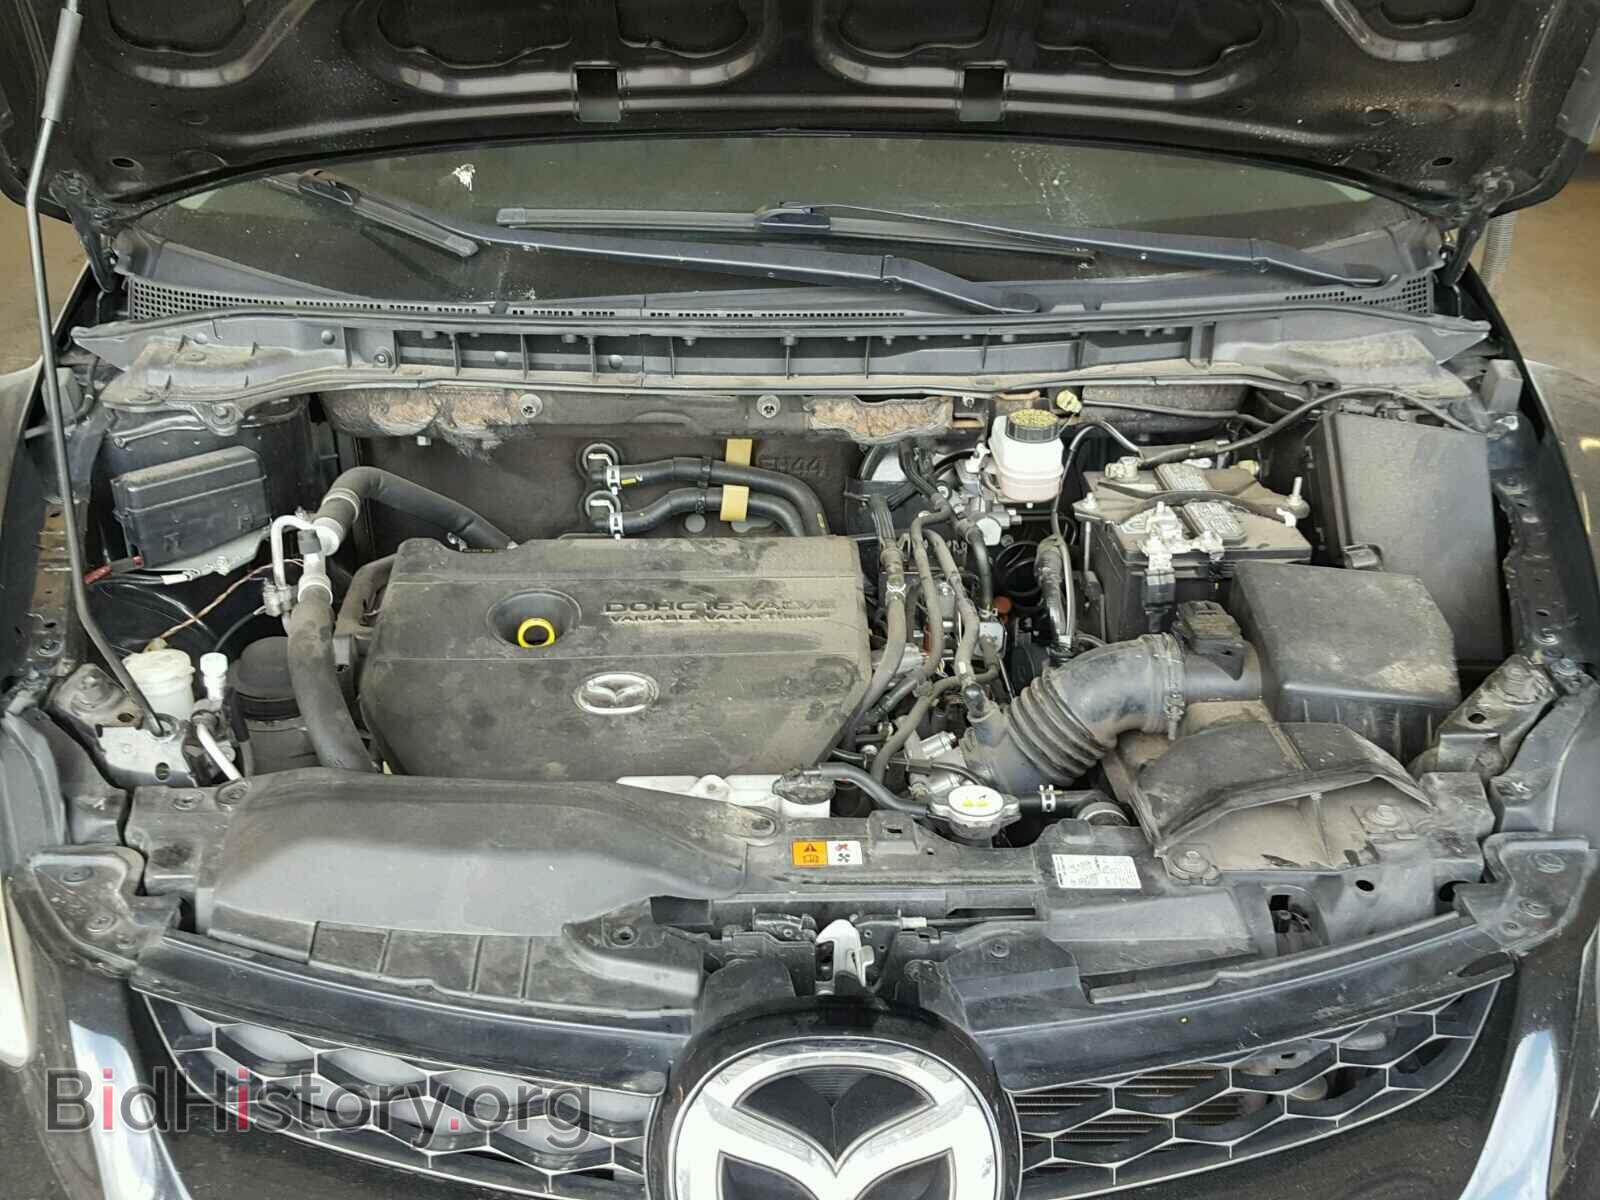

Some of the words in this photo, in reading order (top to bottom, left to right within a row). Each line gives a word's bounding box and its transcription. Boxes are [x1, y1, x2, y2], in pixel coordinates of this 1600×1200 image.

[605, 601, 699, 614] DOHC
[704, 599, 837, 612] 16-VALVE
[608, 613, 701, 624] VARIABLE
[704, 612, 761, 622] VALVE
